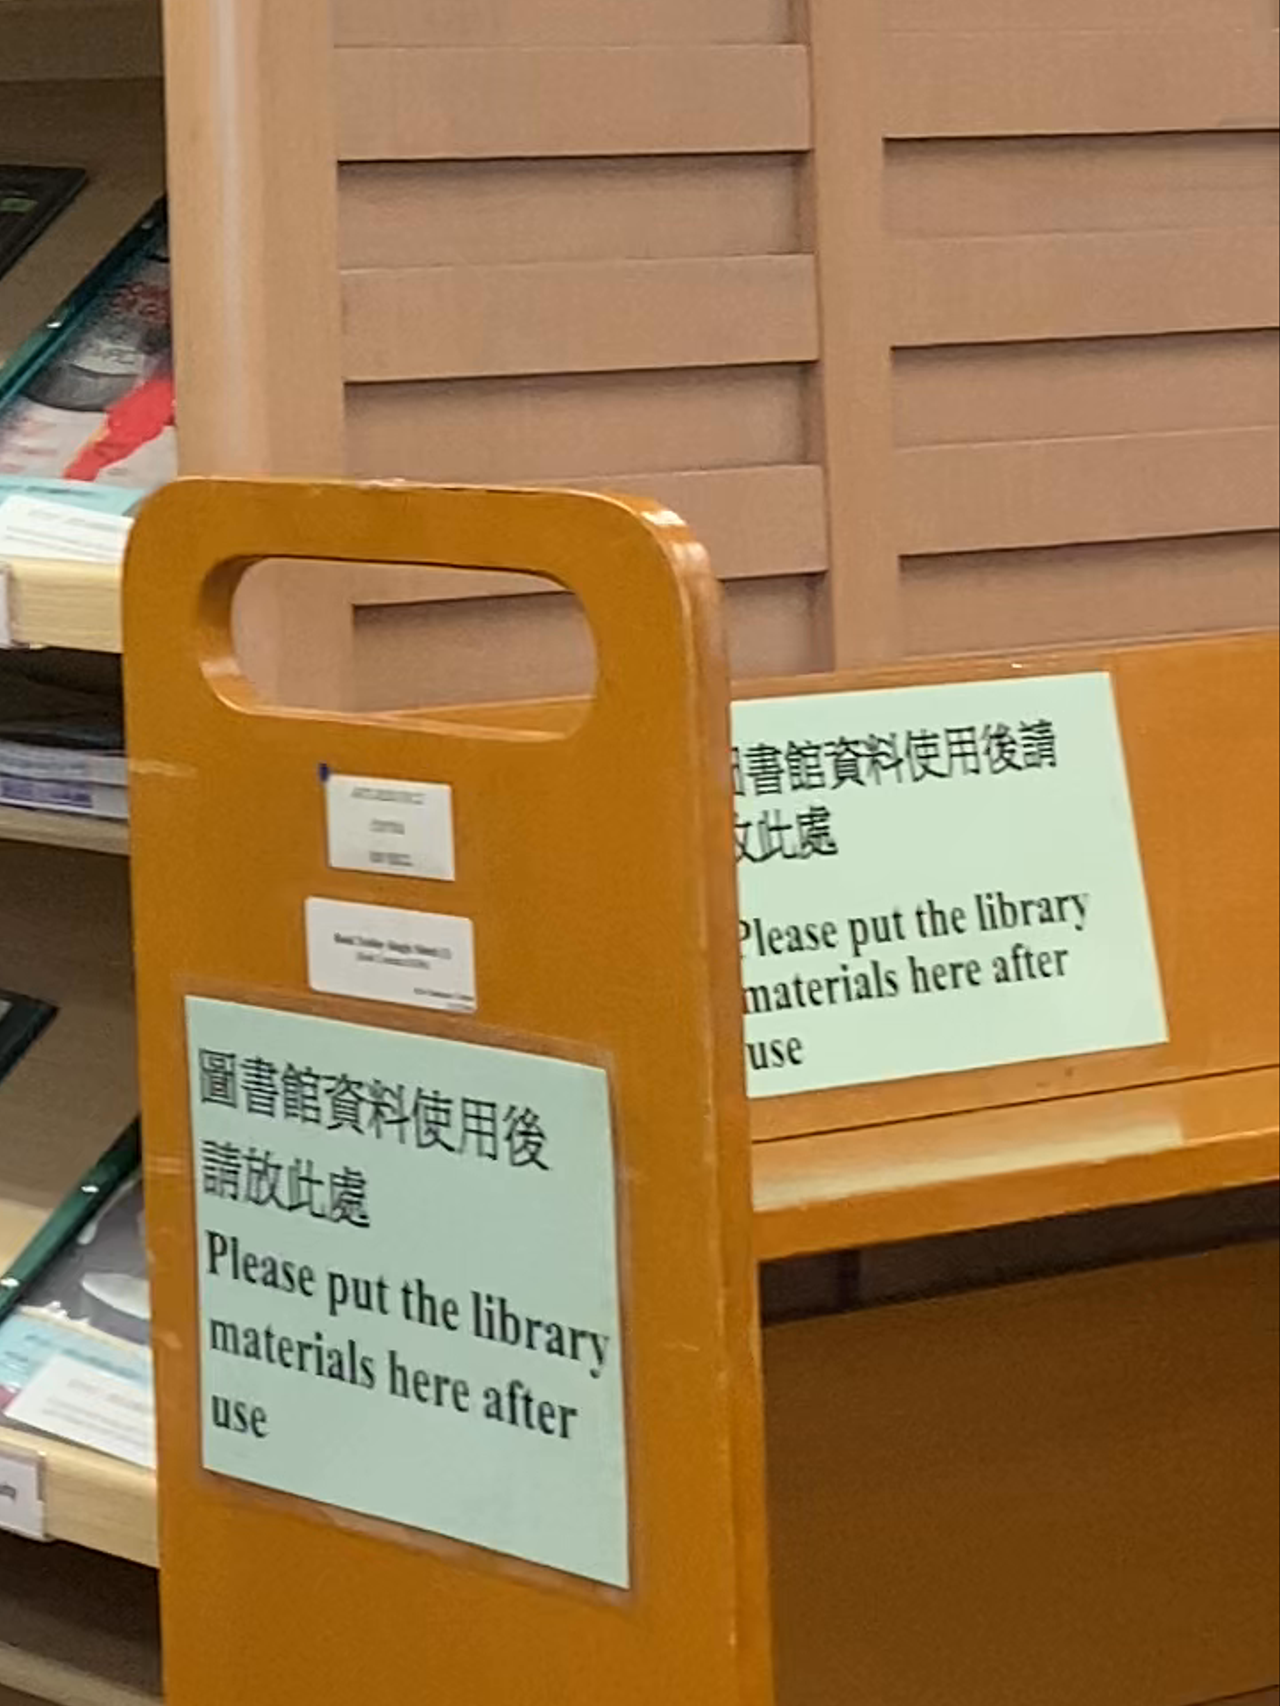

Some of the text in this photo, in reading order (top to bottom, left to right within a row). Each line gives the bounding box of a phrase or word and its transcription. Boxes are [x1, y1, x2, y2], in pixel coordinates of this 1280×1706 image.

[738, 891, 1090, 958] Please put the library
[742, 942, 1068, 1014] materials here after
[747, 1035, 804, 1070] use
[198, 1048, 552, 1171] 圖書館資料使用後
[200, 1140, 370, 1228] 請放此處
[206, 1230, 610, 1378] Please put the library
[210, 1318, 578, 1439] materials here after
[211, 1395, 268, 1438] use
